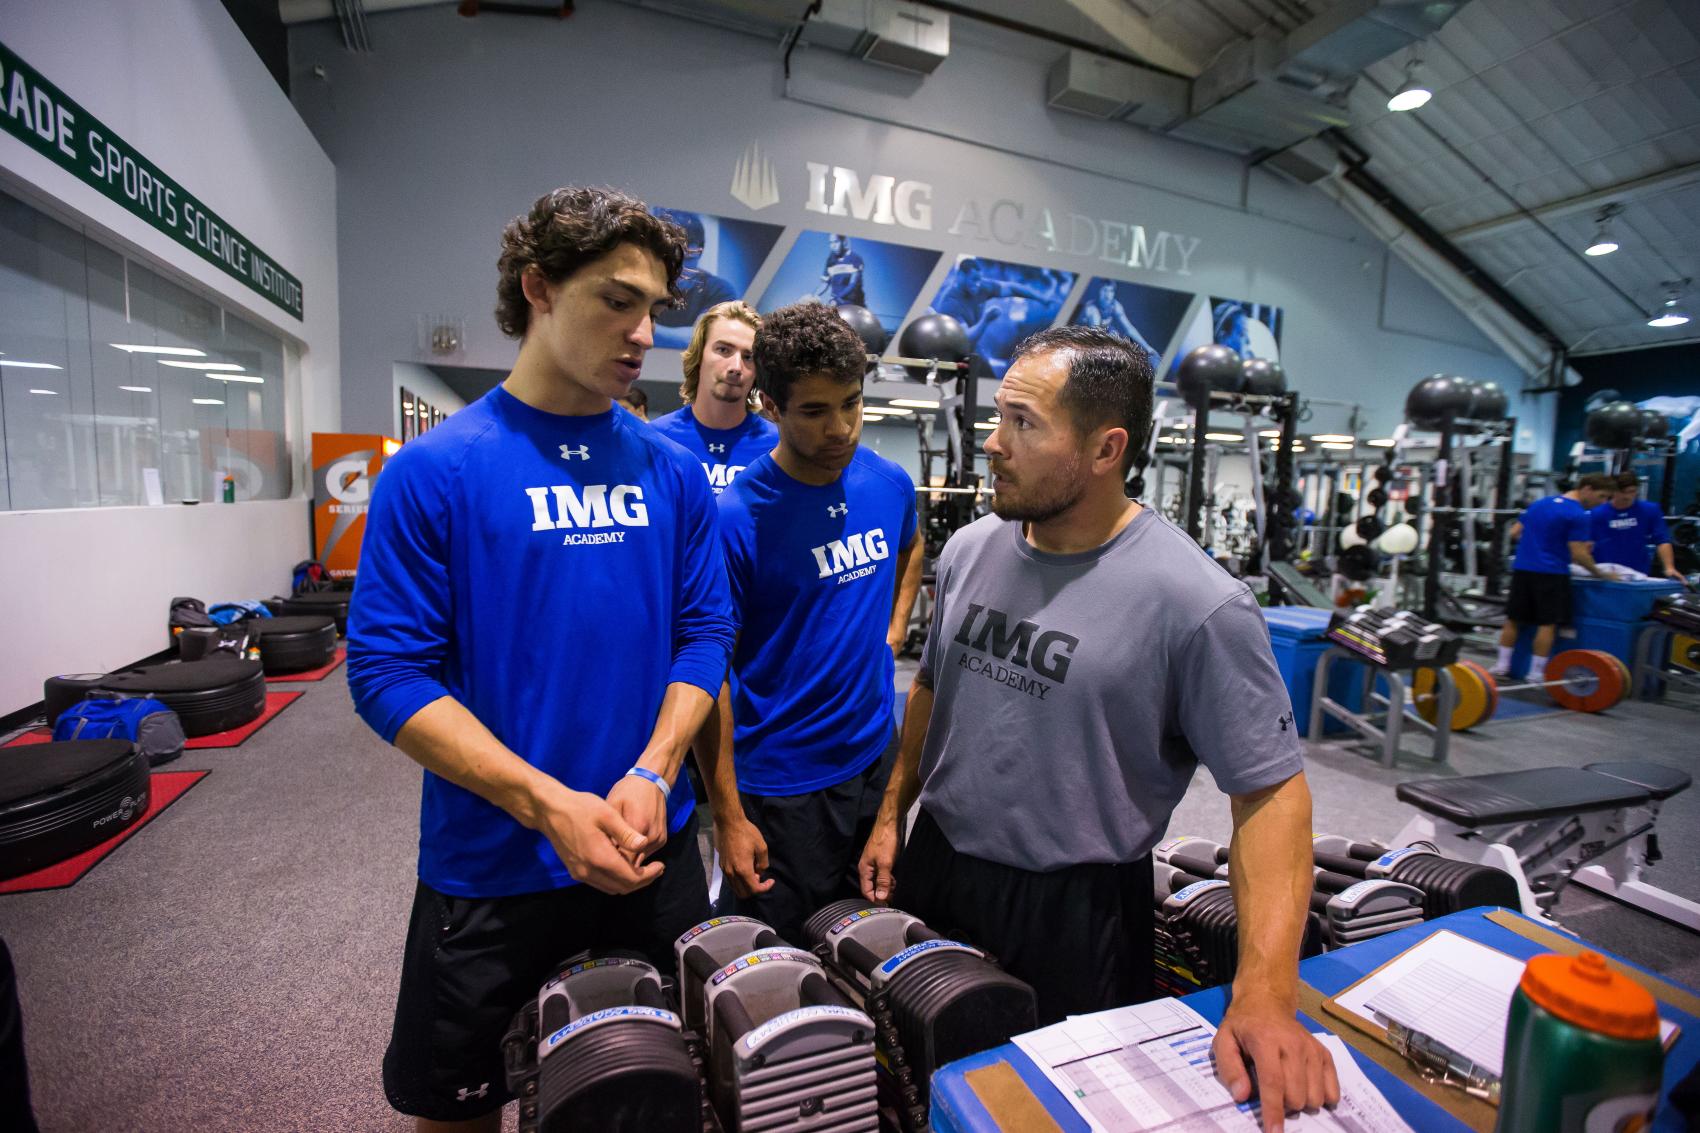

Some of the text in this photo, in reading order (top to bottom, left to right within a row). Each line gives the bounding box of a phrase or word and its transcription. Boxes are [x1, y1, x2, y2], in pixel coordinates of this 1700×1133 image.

[89, 130, 178, 227] SPORTS
[184, 202, 248, 275] SCIENCE
[251, 252, 303, 312] INSTITUTE
[805, 161, 1201, 276] IMG ACADEMY
[525, 484, 649, 532] IMG
[563, 531, 625, 546] ACADEMY
[811, 528, 889, 579] IMG
[838, 565, 876, 585] ACADEMY
[953, 603, 1080, 684] IMG
[958, 653, 1050, 700] ACADEMY
[93, 809, 122, 829] POWER
